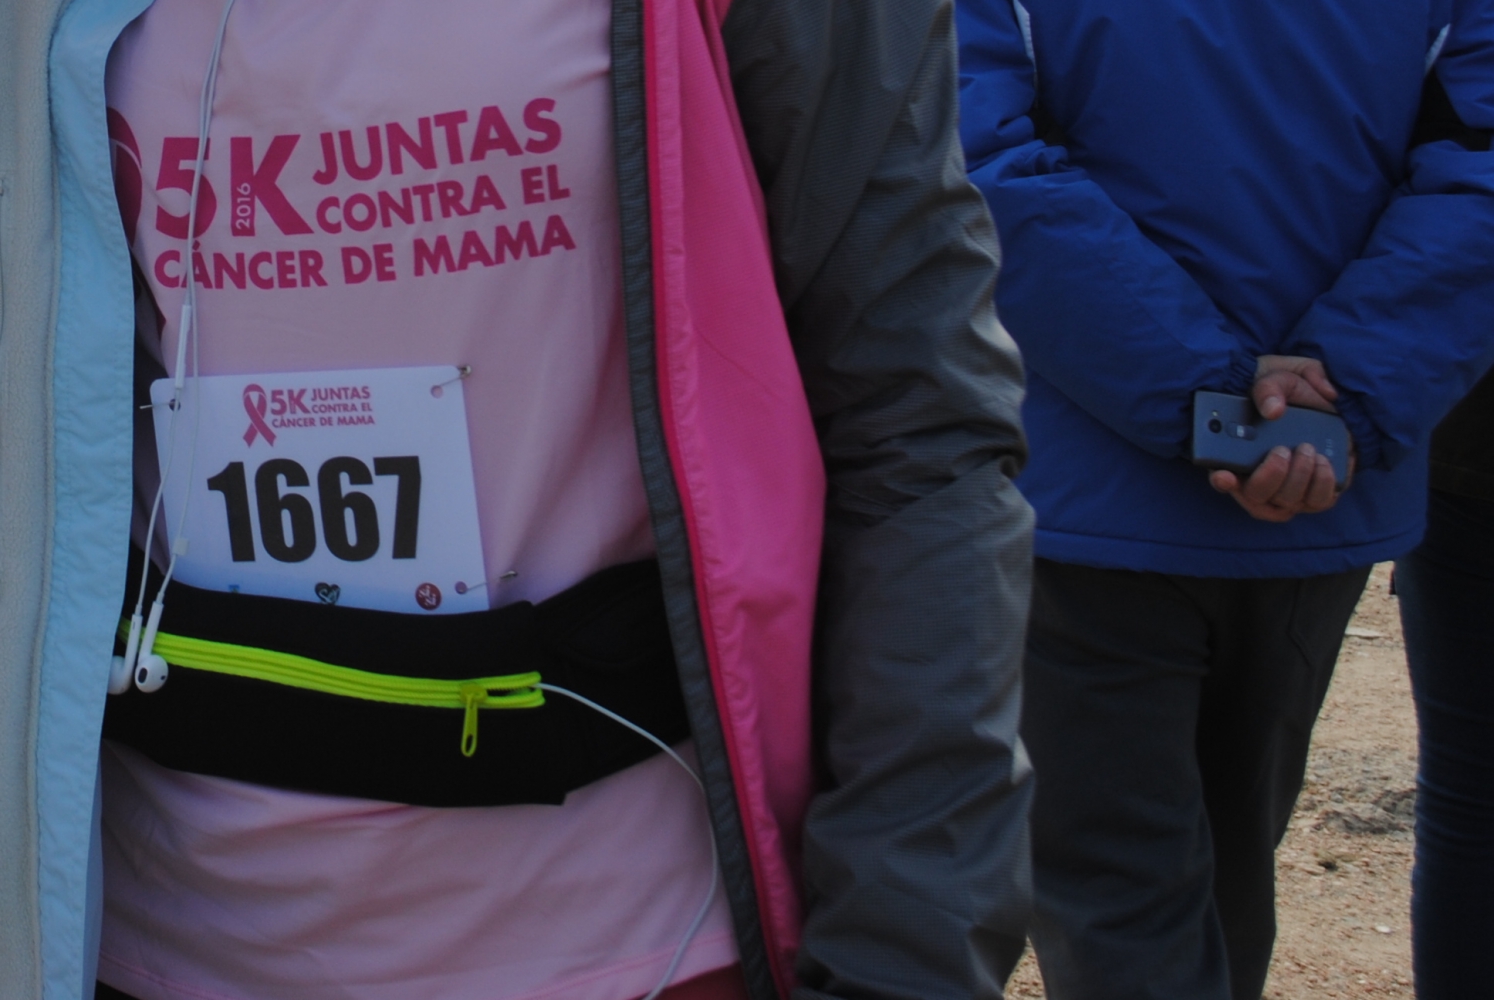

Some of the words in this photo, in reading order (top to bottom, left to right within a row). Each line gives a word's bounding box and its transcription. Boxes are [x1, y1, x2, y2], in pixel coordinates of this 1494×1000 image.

[312, 97, 563, 186] JUNTAS
[155, 135, 314, 239] 5K
[236, 182, 252, 230] 2016
[315, 175, 507, 235] CONTRA
[520, 164, 571, 206] EL
[154, 240, 329, 291] CÁNCER
[341, 243, 397, 285] DE
[413, 214, 577, 278] MAMA
[271, 388, 311, 415] 5K
[271, 416, 317, 428] CÁNCER
[319, 417, 334, 427] DE
[337, 415, 375, 425] MAMA
[310, 386, 371, 402] JUNTAS
[311, 403, 358, 414] CONTRA
[361, 403, 372, 412] EL
[206, 455, 422, 564] 1667
